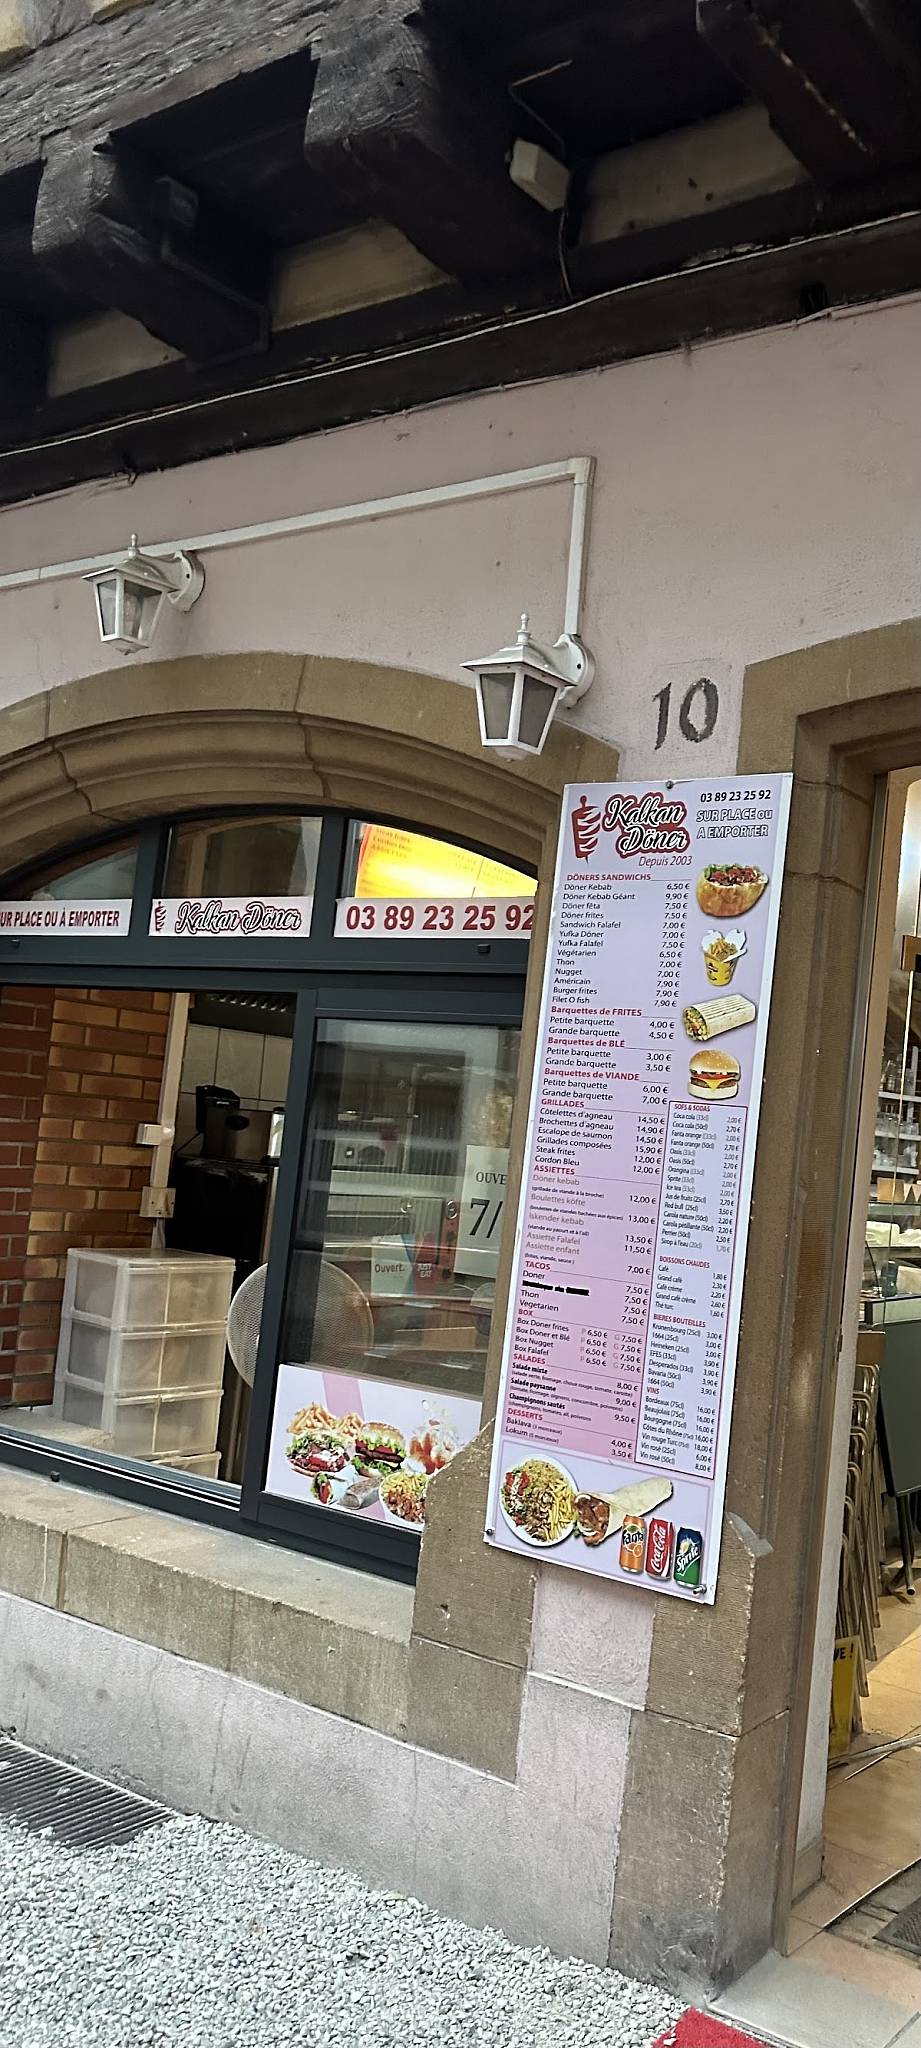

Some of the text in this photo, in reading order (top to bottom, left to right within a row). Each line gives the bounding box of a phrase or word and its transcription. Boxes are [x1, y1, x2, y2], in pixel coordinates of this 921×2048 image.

[652, 678, 718, 750] 10
[701, 790, 771, 802] 03 89 23 25 92
[605, 796, 683, 827] Kalkan
[697, 809, 772, 822] SUR PLACE ou
[620, 826, 687, 851] Döner
[697, 826, 768, 839] A EMPORTER
[639, 856, 692, 868] Depuis 2003
[0, 908, 119, 927] UR PLACE OU À EMPORTER
[176, 900, 300, 934] Kalkan Döner
[346, 905, 534, 930] 03 89 23 25 92
[558, 949, 596, 957] Végétarien
[554, 987, 577, 995] Burger
[552, 1006, 597, 1015] Barquettes
[550, 1016, 572, 1024] Petite
[575, 1018, 614, 1026] barquette
[580, 1028, 620, 1036] barquette
[548, 1037, 593, 1046] Barquettes
[547, 1047, 664, 1061] Petite barquette 3,00
[577, 1059, 616, 1068] barquette
[646, 1064, 663, 1072] 3,50
[545, 1068, 590, 1077] Barquettes
[605, 1072, 640, 1080] VIANDE
[544, 1078, 566, 1086] Petite
[568, 1079, 607, 1089] barquette
[543, 1089, 660, 1104] Grande barquette 7,00
[542, 1099, 584, 1107] GRILLADES
[540, 1108, 658, 1124] Côtelettes d'agneau 14,50
[539, 1118, 657, 1134] Brochettes d'agneau 14,90
[539, 1127, 569, 1136] Escalope
[637, 1136, 656, 1144] 14,50
[537, 1136, 655, 1154] Grillades composées 15,90
[536, 1146, 555, 1154] Steak
[635, 1156, 655, 1164] 12,00
[534, 1165, 575, 1175] ASSIETTES
[535, 1155, 561, 1164] Cordon
[633, 1166, 653, 1174] 12,00
[525, 1261, 550, 1270] TACOS
[660, 1256, 710, 1268] BOISSONS CHAUDES
[521, 1290, 539, 1298] Thon
[673, 1317, 706, 1327] BOUTEILLES
[513, 1353, 545, 1364] SALADES
[511, 1377, 556, 1391] Salade paysanne
[509, 1393, 565, 1410] Champignons sautés
[646, 1396, 669, 1406] Bordeaux
[508, 1408, 542, 1420] DESSERTS
[507, 1417, 531, 1428] Baklava
[506, 1427, 528, 1437] Lokum
[677, 1547, 698, 1571] Sprite
